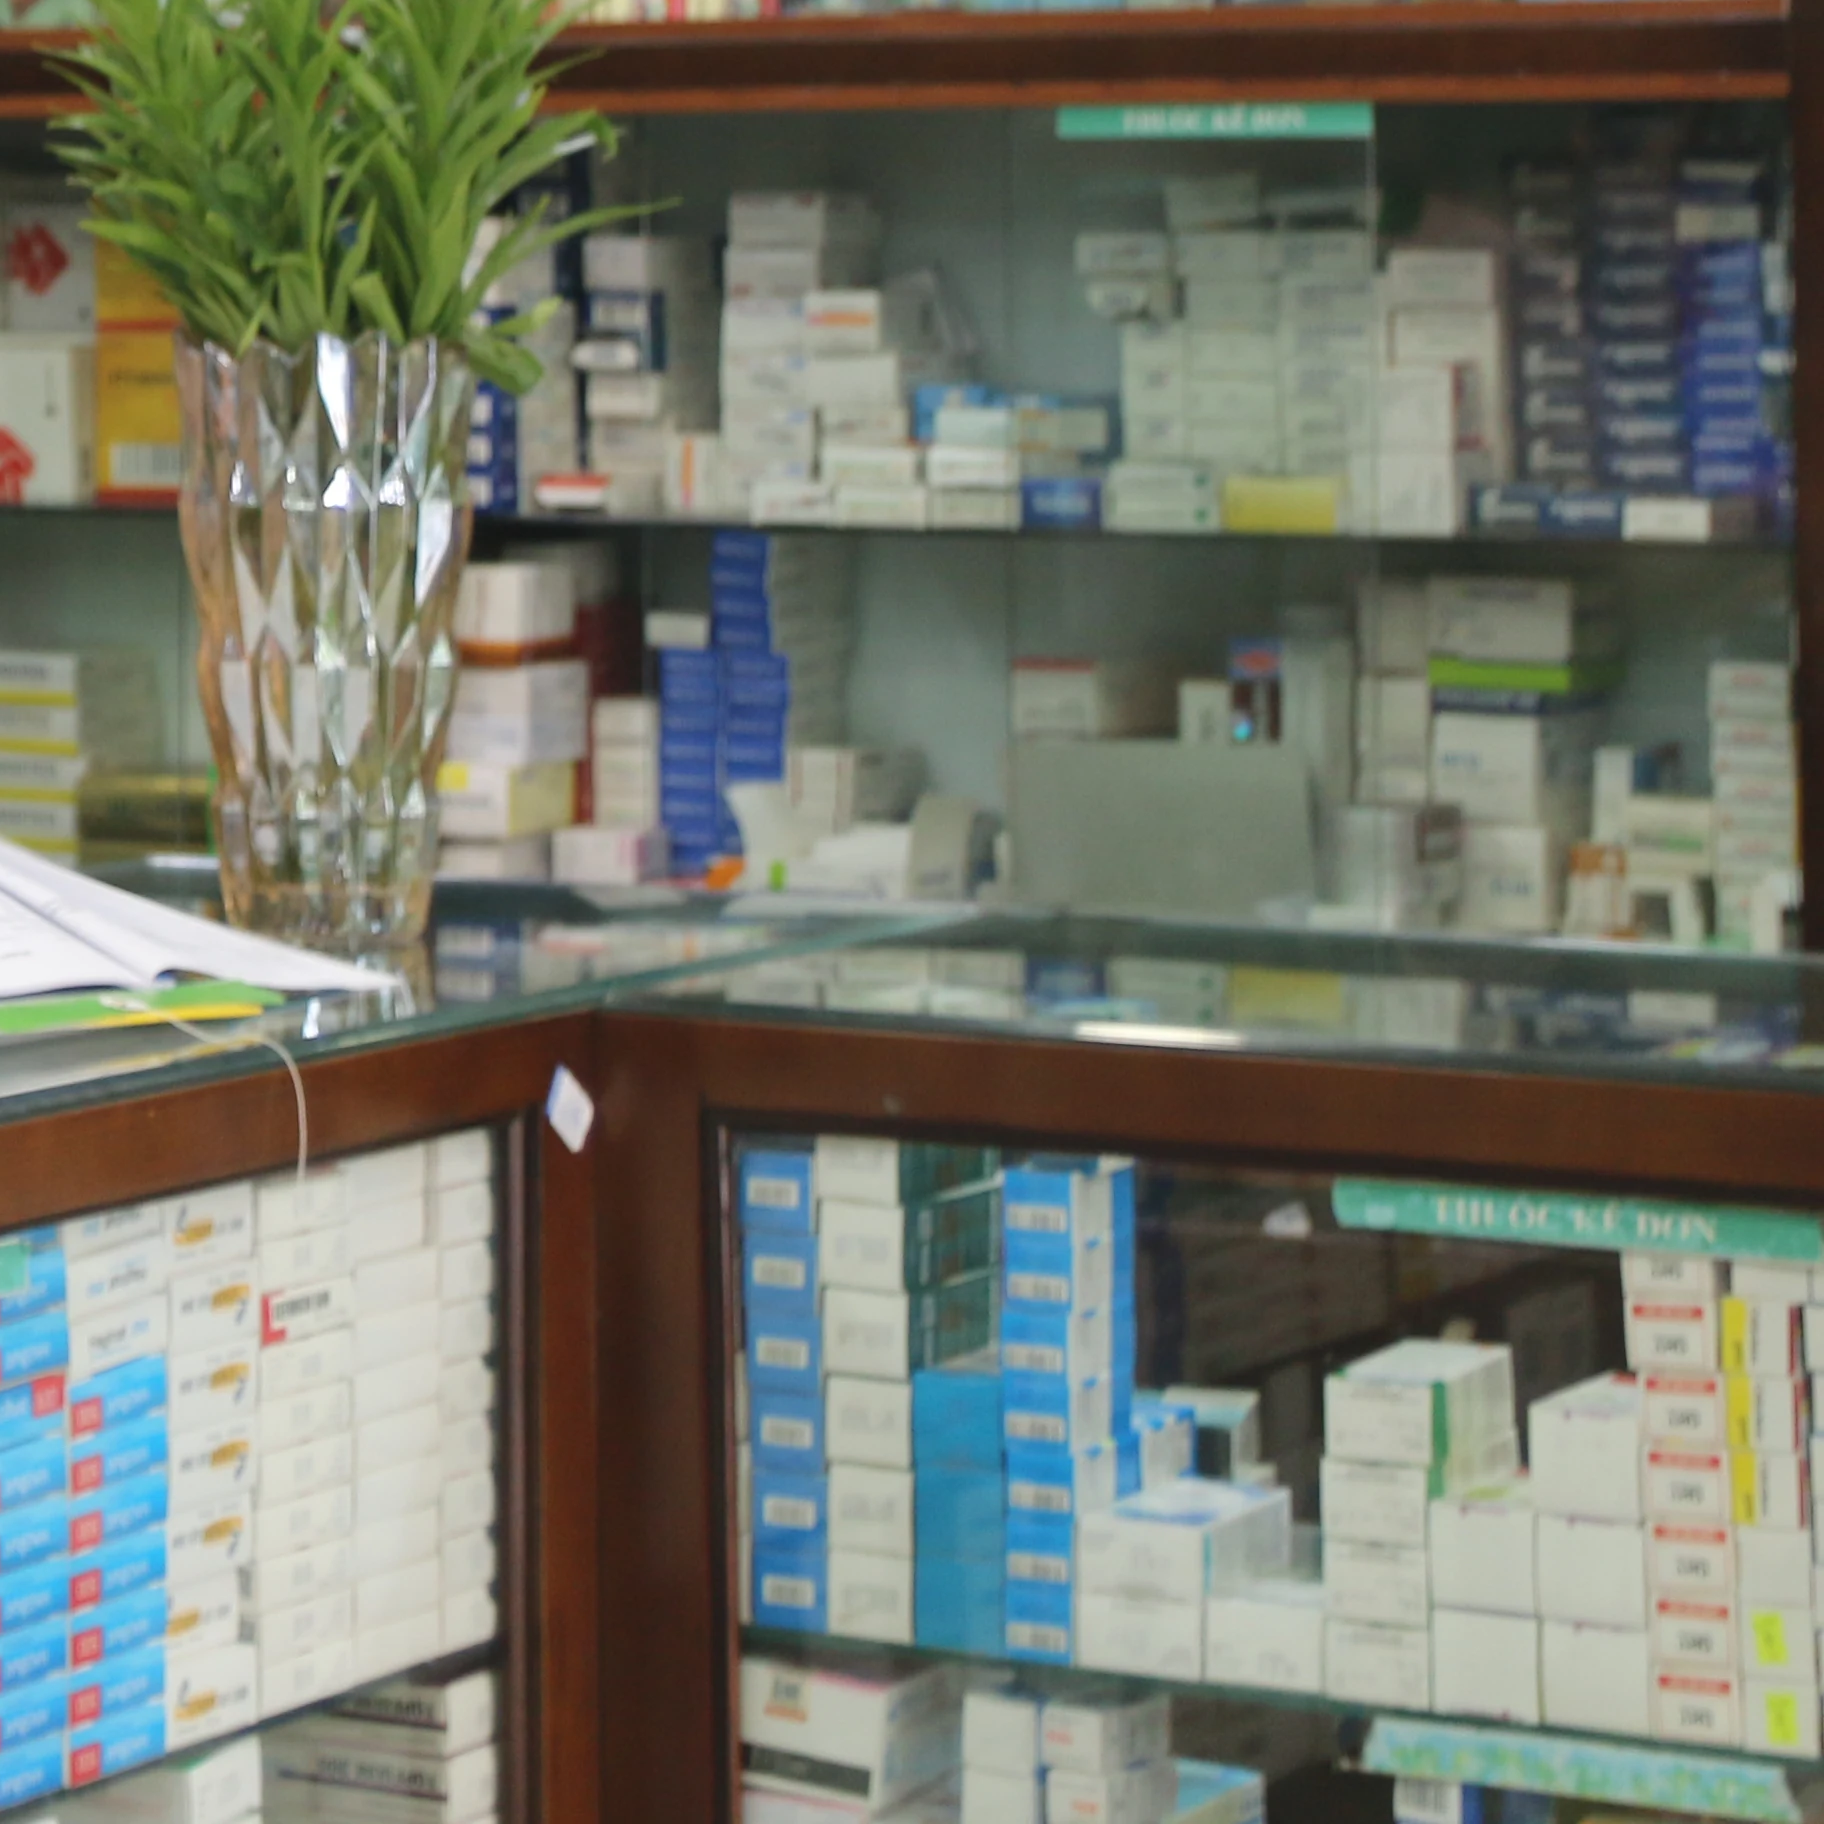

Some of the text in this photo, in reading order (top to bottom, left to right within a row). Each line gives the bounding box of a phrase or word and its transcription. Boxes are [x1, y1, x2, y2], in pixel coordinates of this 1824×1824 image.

[1436, 1191, 1718, 1244] THUỐC KÊ ĐƠN
